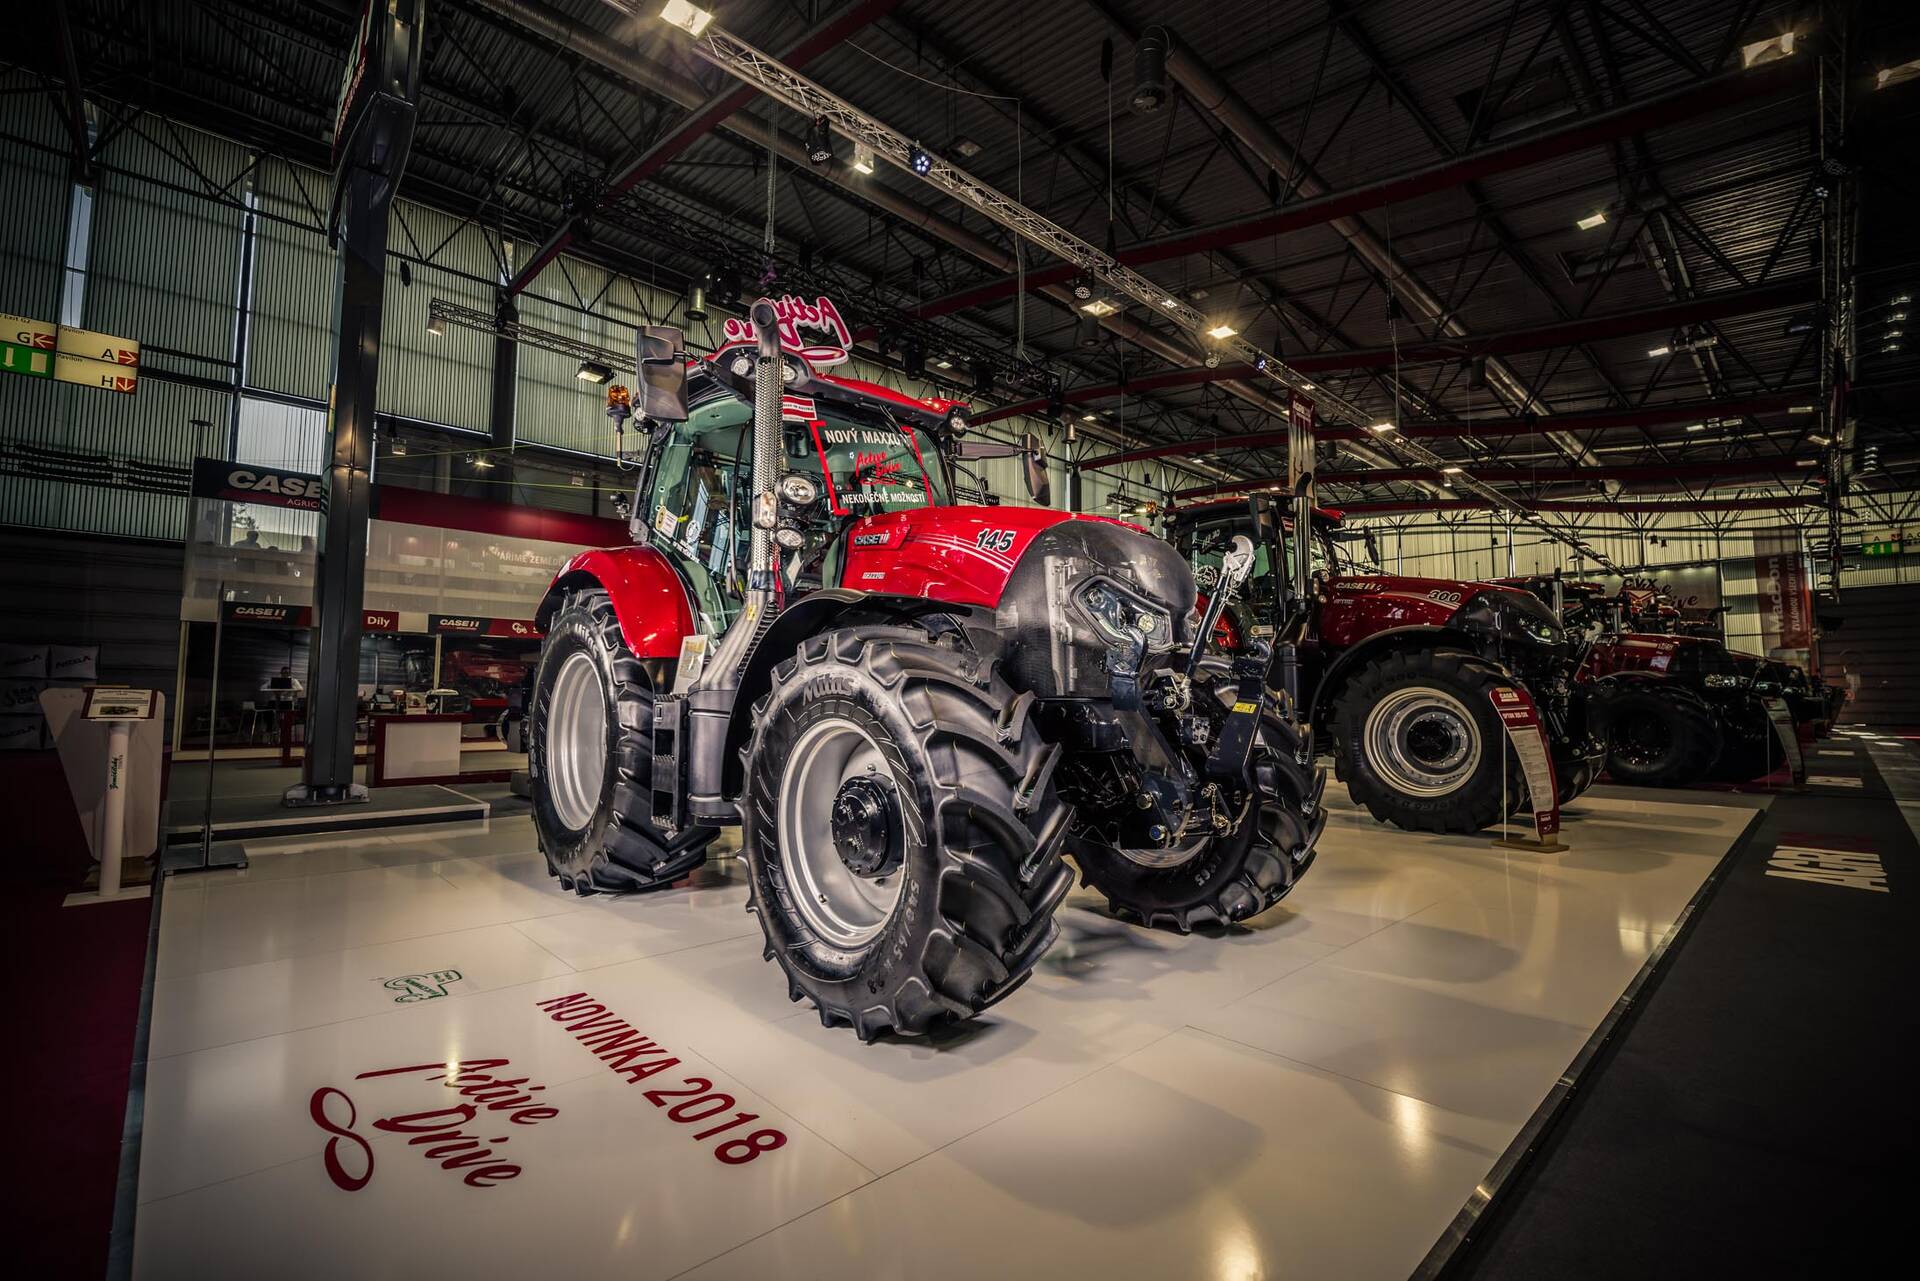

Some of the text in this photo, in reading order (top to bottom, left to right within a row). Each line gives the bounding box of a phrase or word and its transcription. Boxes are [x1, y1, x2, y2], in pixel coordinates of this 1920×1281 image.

[17, 331, 31, 344] G
[101, 348, 115, 360] A
[101, 375, 114, 388] H
[824, 427, 858, 444] NOVÝ
[854, 535, 880, 545] CASE
[976, 528, 1017, 553] 145
[1335, 582, 1365, 590] CASE
[1426, 589, 1461, 603] 300
[1767, 557, 1785, 632] MacDon
[235, 605, 273, 617] CASE
[439, 618, 469, 627] CASE
[803, 674, 854, 706] Mitas
[535, 992, 788, 1165] NOVINKA 2018
[355, 1058, 560, 1125] Active
[372, 1103, 523, 1188] Drive
